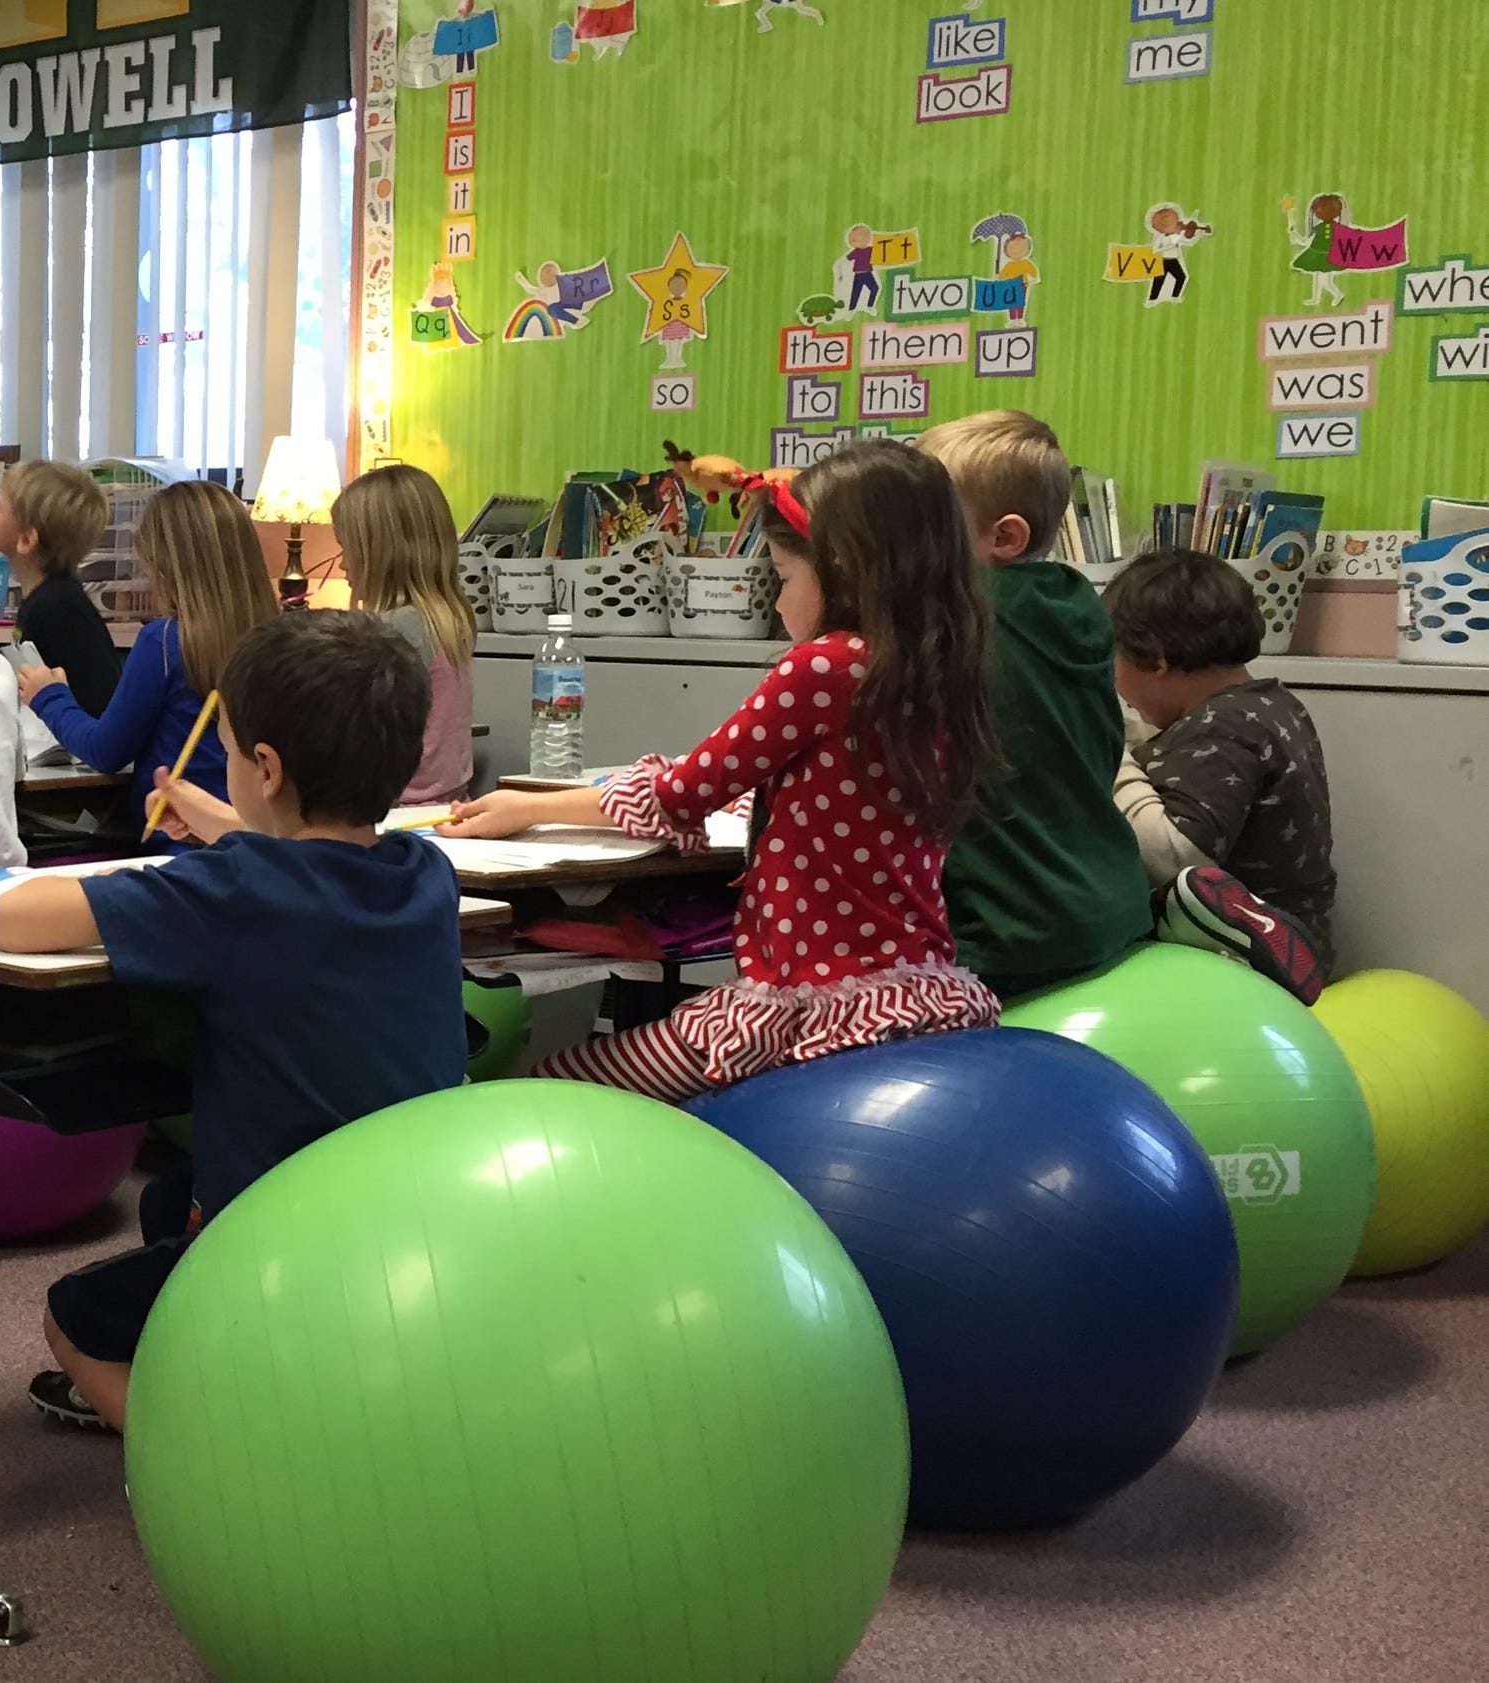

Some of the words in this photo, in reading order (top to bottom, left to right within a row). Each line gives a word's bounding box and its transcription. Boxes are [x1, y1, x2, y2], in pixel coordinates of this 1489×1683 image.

[937, 25, 996, 58] like
[1136, 41, 1202, 72] me
[454, 89, 469, 120] I
[925, 74, 1003, 113] look
[454, 139, 469, 166] is
[454, 182, 469, 210] it
[449, 227, 470, 254] in
[896, 280, 963, 310] two
[1270, 310, 1384, 350] went
[790, 334, 845, 365] the
[869, 330, 963, 361] them
[982, 336, 1031, 368] up
[656, 384, 689, 406] so
[799, 384, 832, 414] to
[866, 378, 922, 410] this
[1277, 373, 1364, 400] was
[1286, 422, 1354, 448] we
[1324, 534, 1336, 552] B
[1386, 534, 1398, 552] 2
[1346, 558, 1359, 576] C
[1374, 558, 1382, 576] 1
